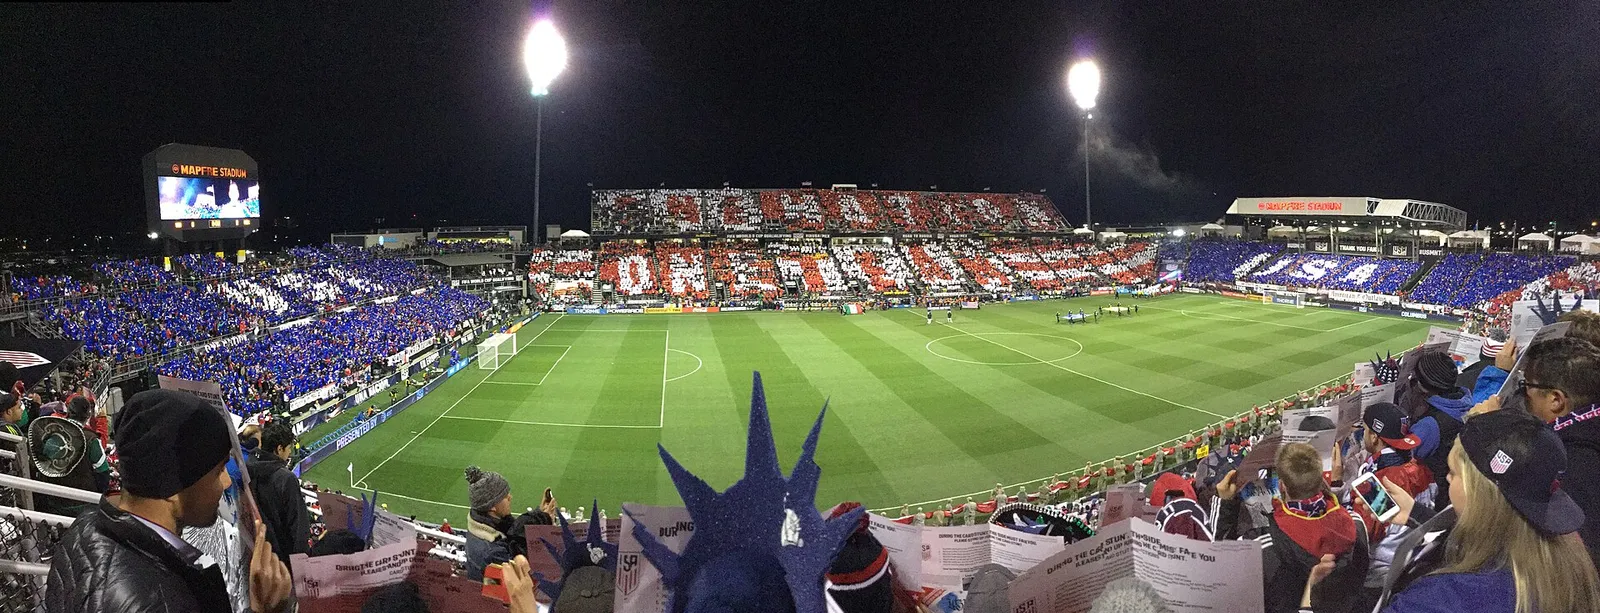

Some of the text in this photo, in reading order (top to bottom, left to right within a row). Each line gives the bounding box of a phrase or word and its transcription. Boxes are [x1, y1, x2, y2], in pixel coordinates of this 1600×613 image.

[180, 164, 247, 179] MAPFRE STADIUM
[1308, 202, 1343, 212] STADIUM
[336, 417, 378, 450] PRESENTED BY
[1496, 451, 1512, 466] USA
[1198, 552, 1216, 563] YOU
